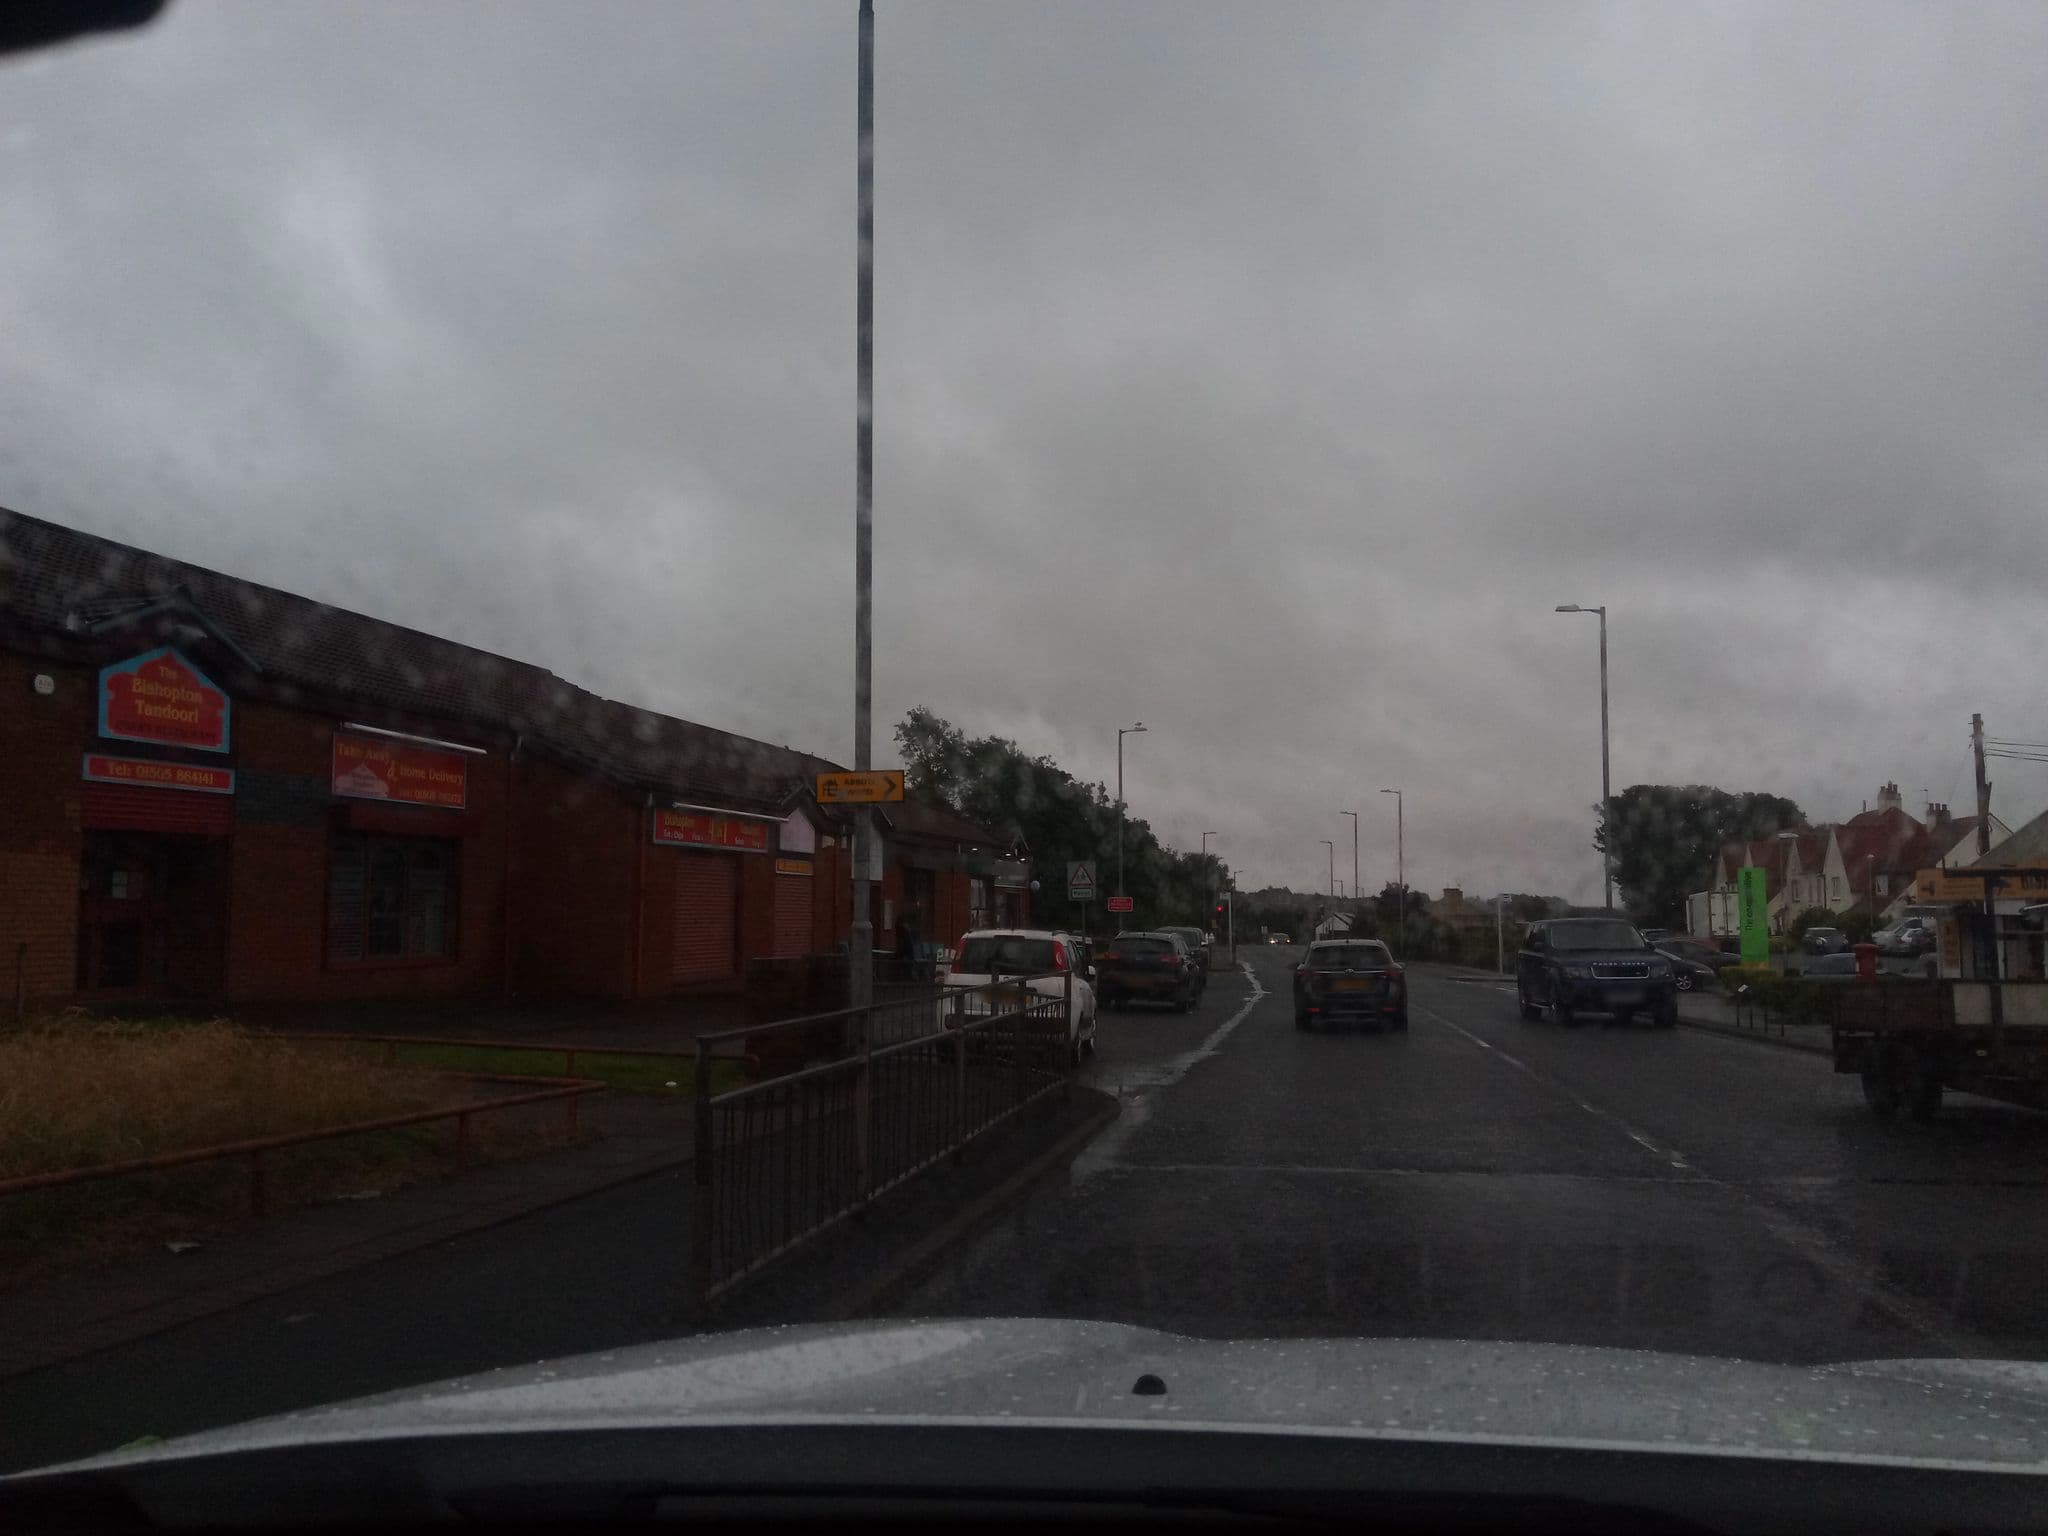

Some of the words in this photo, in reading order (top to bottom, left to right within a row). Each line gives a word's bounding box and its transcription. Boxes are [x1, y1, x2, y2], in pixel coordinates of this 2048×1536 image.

[159, 666, 178, 680] The
[132, 678, 203, 704] Bishopton
[135, 699, 199, 723] Tandoori
[109, 762, 132, 776] Tel:
[428, 767, 464, 786] Delivery
